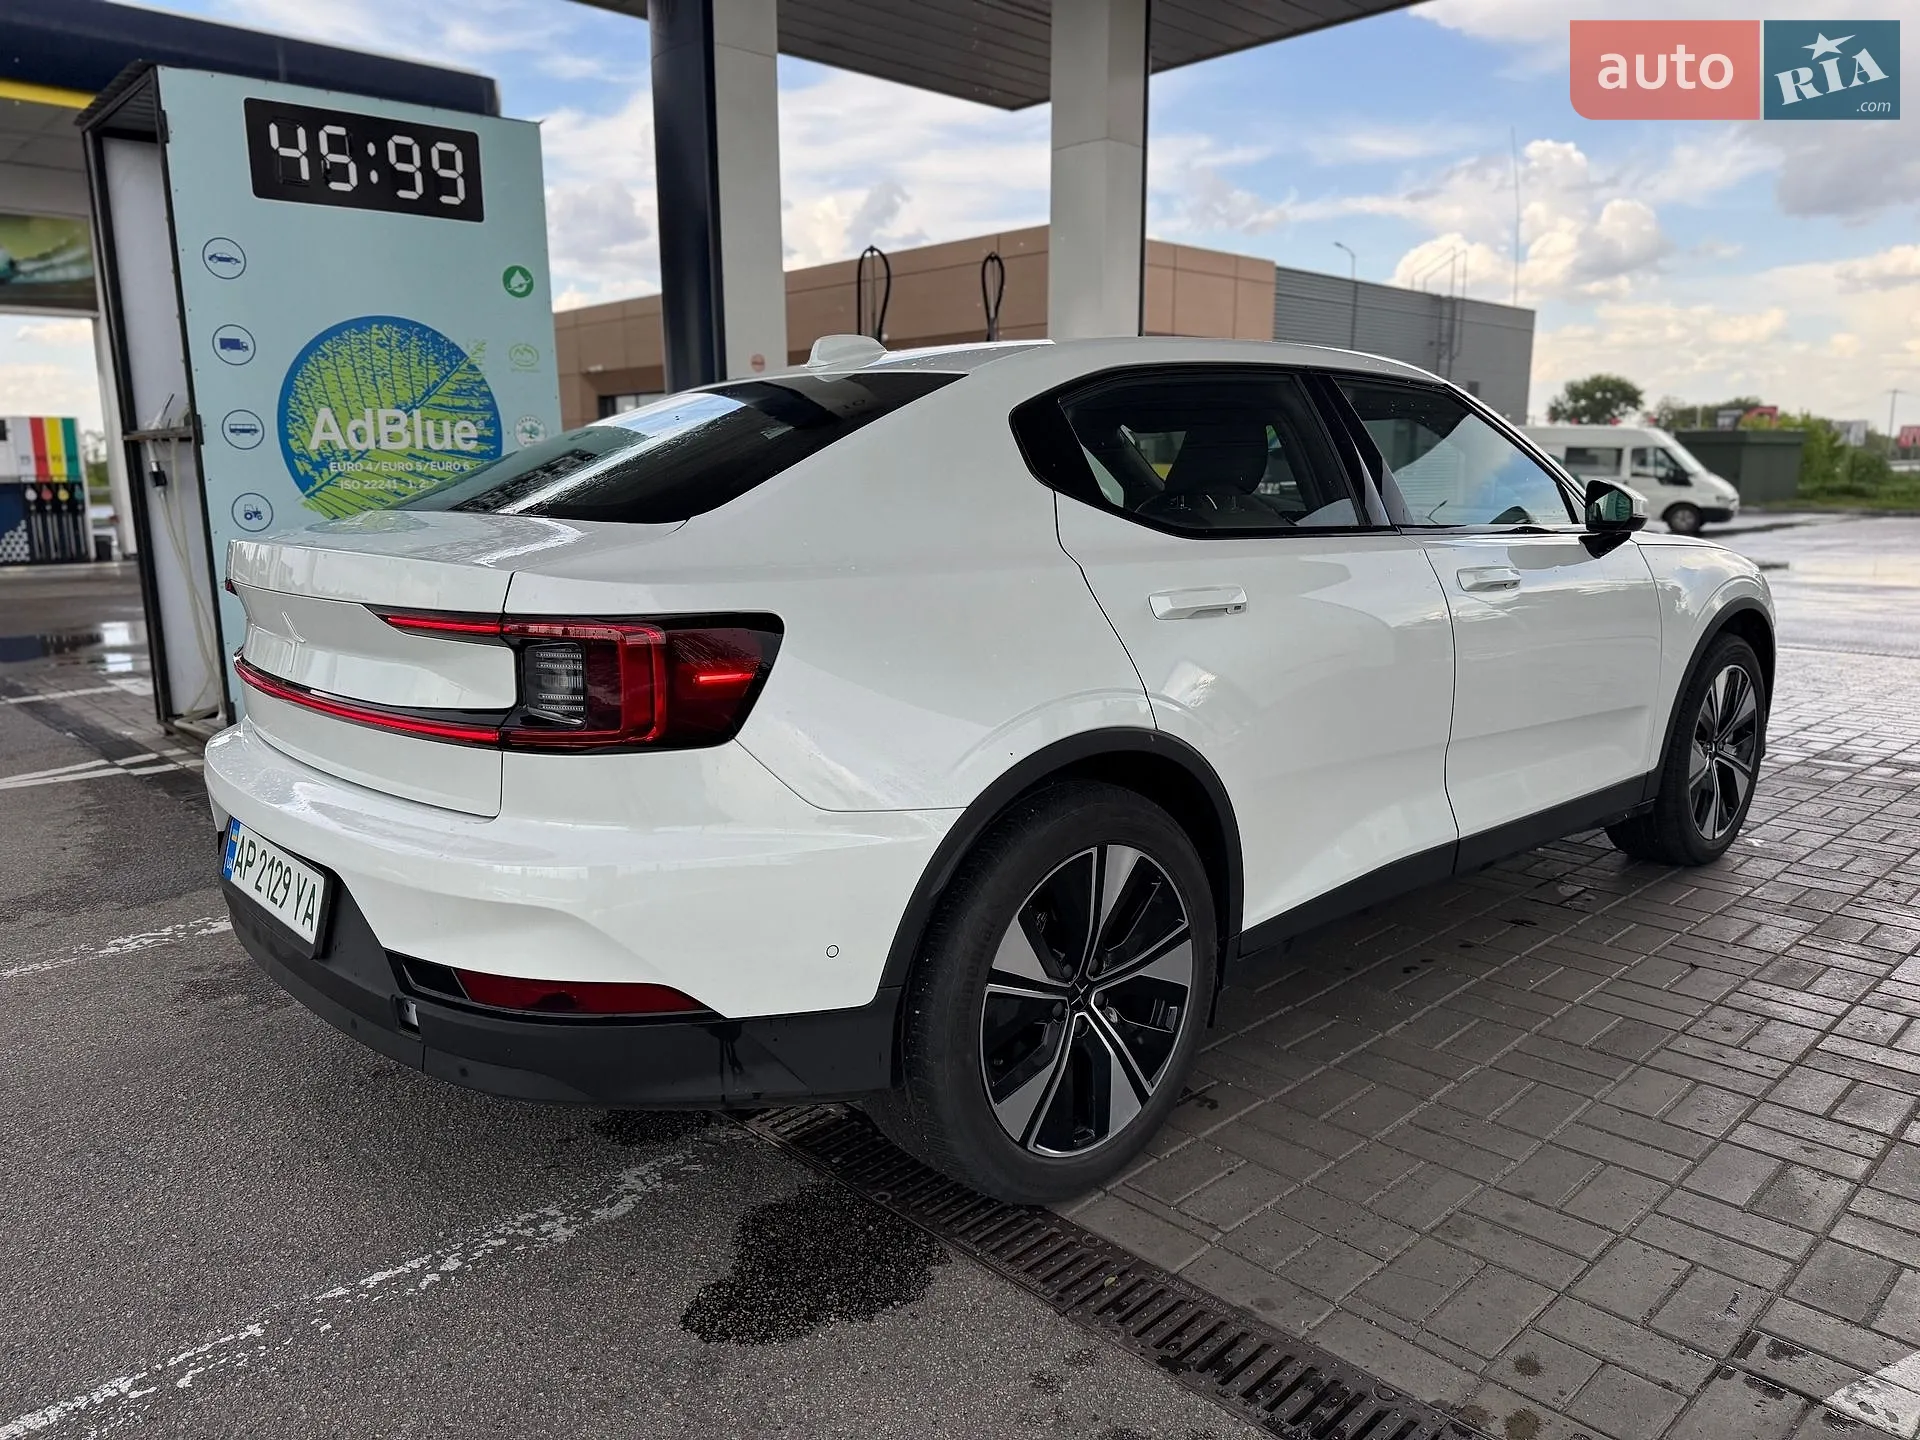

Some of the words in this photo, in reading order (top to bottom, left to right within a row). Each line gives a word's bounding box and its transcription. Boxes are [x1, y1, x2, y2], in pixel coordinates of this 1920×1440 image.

[329, 460, 363, 472] EURO
[340, 479, 361, 490] ISO
[233, 835, 257, 881] AP
[254, 849, 292, 909] 2129
[294, 872, 317, 932] YA
